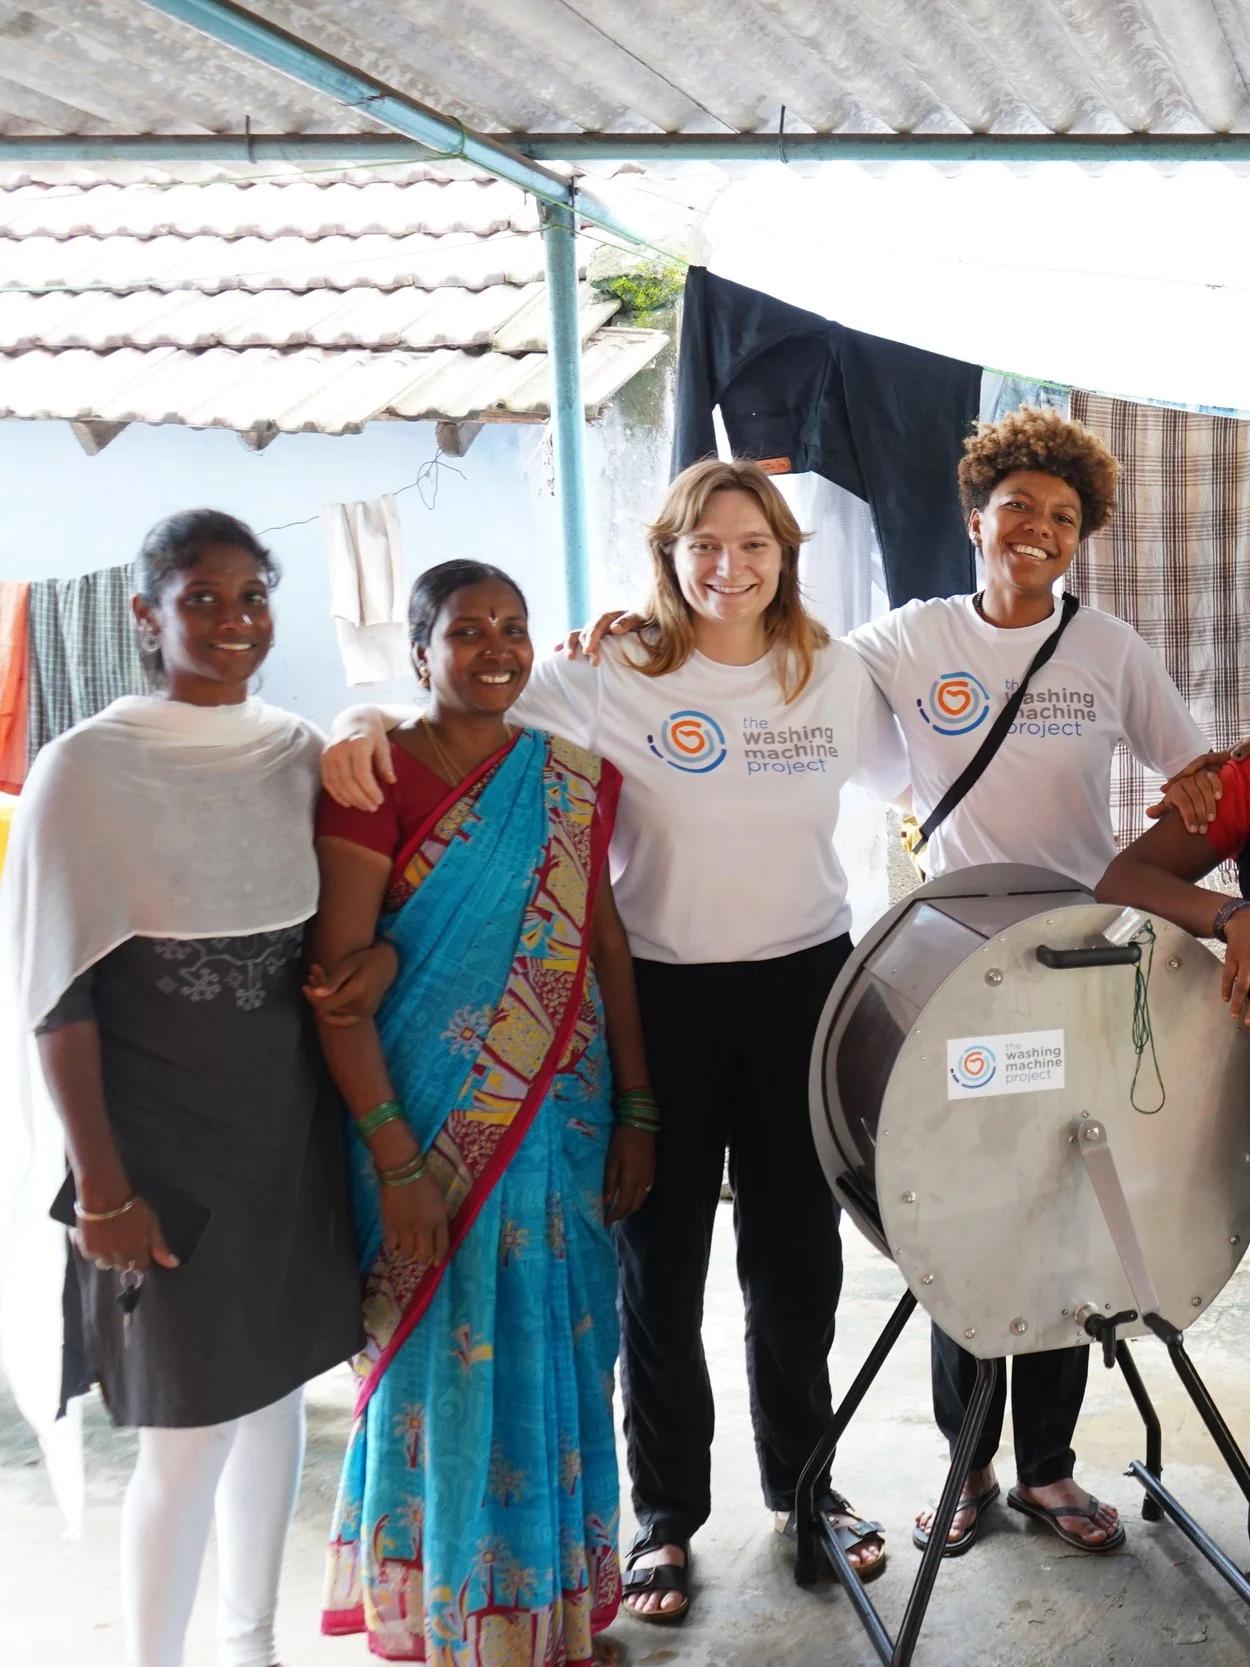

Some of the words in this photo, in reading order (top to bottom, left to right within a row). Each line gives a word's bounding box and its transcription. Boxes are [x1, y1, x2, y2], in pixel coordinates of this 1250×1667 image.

[1005, 679, 1021, 690] th
[743, 716, 769, 729] the
[742, 726, 833, 745] washing
[744, 740, 839, 760] machine
[747, 758, 827, 775] project
[1006, 1046, 1061, 1060] washing
[1005, 1058, 1063, 1072] machine
[1005, 1069, 1052, 1085] project
